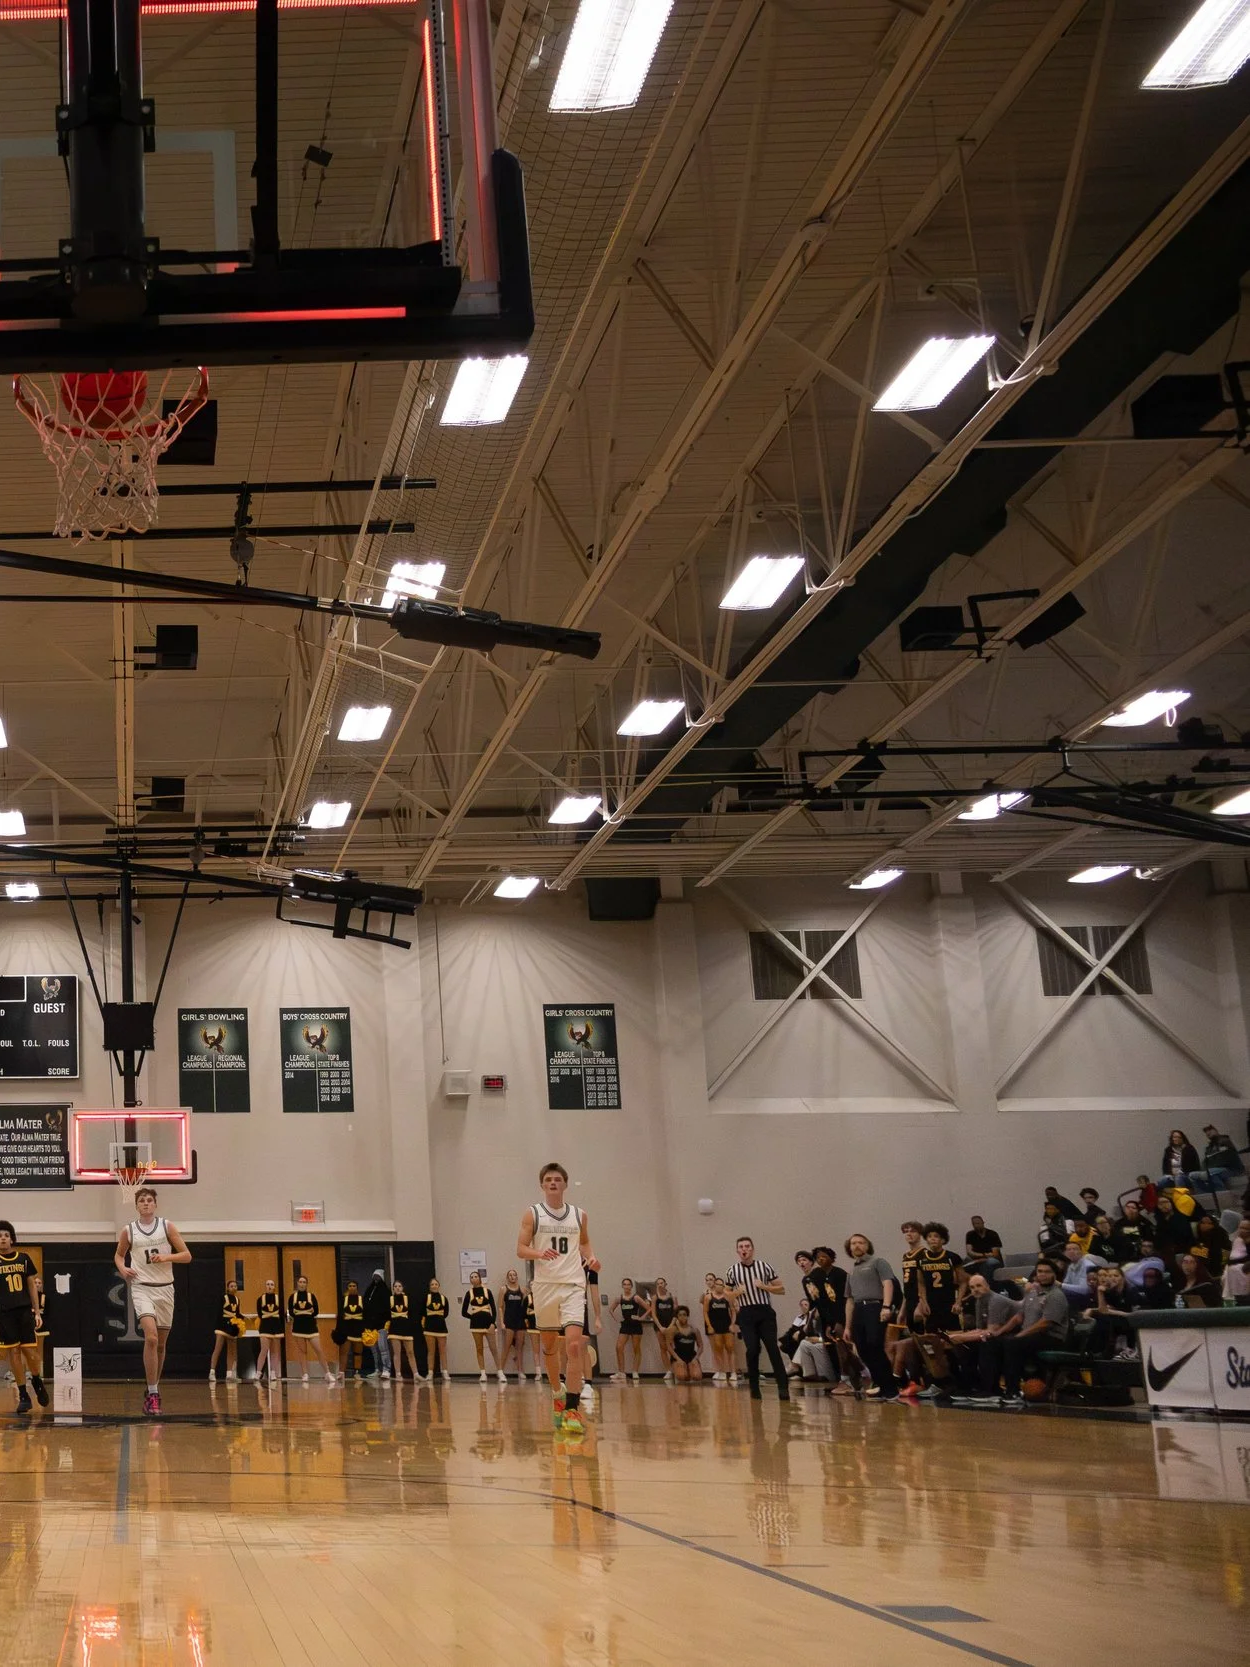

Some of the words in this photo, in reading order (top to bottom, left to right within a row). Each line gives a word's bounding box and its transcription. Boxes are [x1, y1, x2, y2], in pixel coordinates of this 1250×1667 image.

[33, 1002, 65, 1013] GUEST
[181, 1013, 207, 1021] GIRLS'
[22, 1039, 41, 1047] T.O.L.
[47, 1039, 70, 1047] FOULS
[47, 1067, 70, 1075] SCORE
[16, 1118, 42, 1129] MATER
[11, 1133, 20, 1141] OUR
[21, 1133, 33, 1141] ALMA
[34, 1133, 49, 1141] MATER
[49, 1156, 65, 1164] FRIEND
[551, 1236, 568, 1255] 10
[5, 1273, 23, 1293] 10
[931, 1271, 943, 1288] 2
